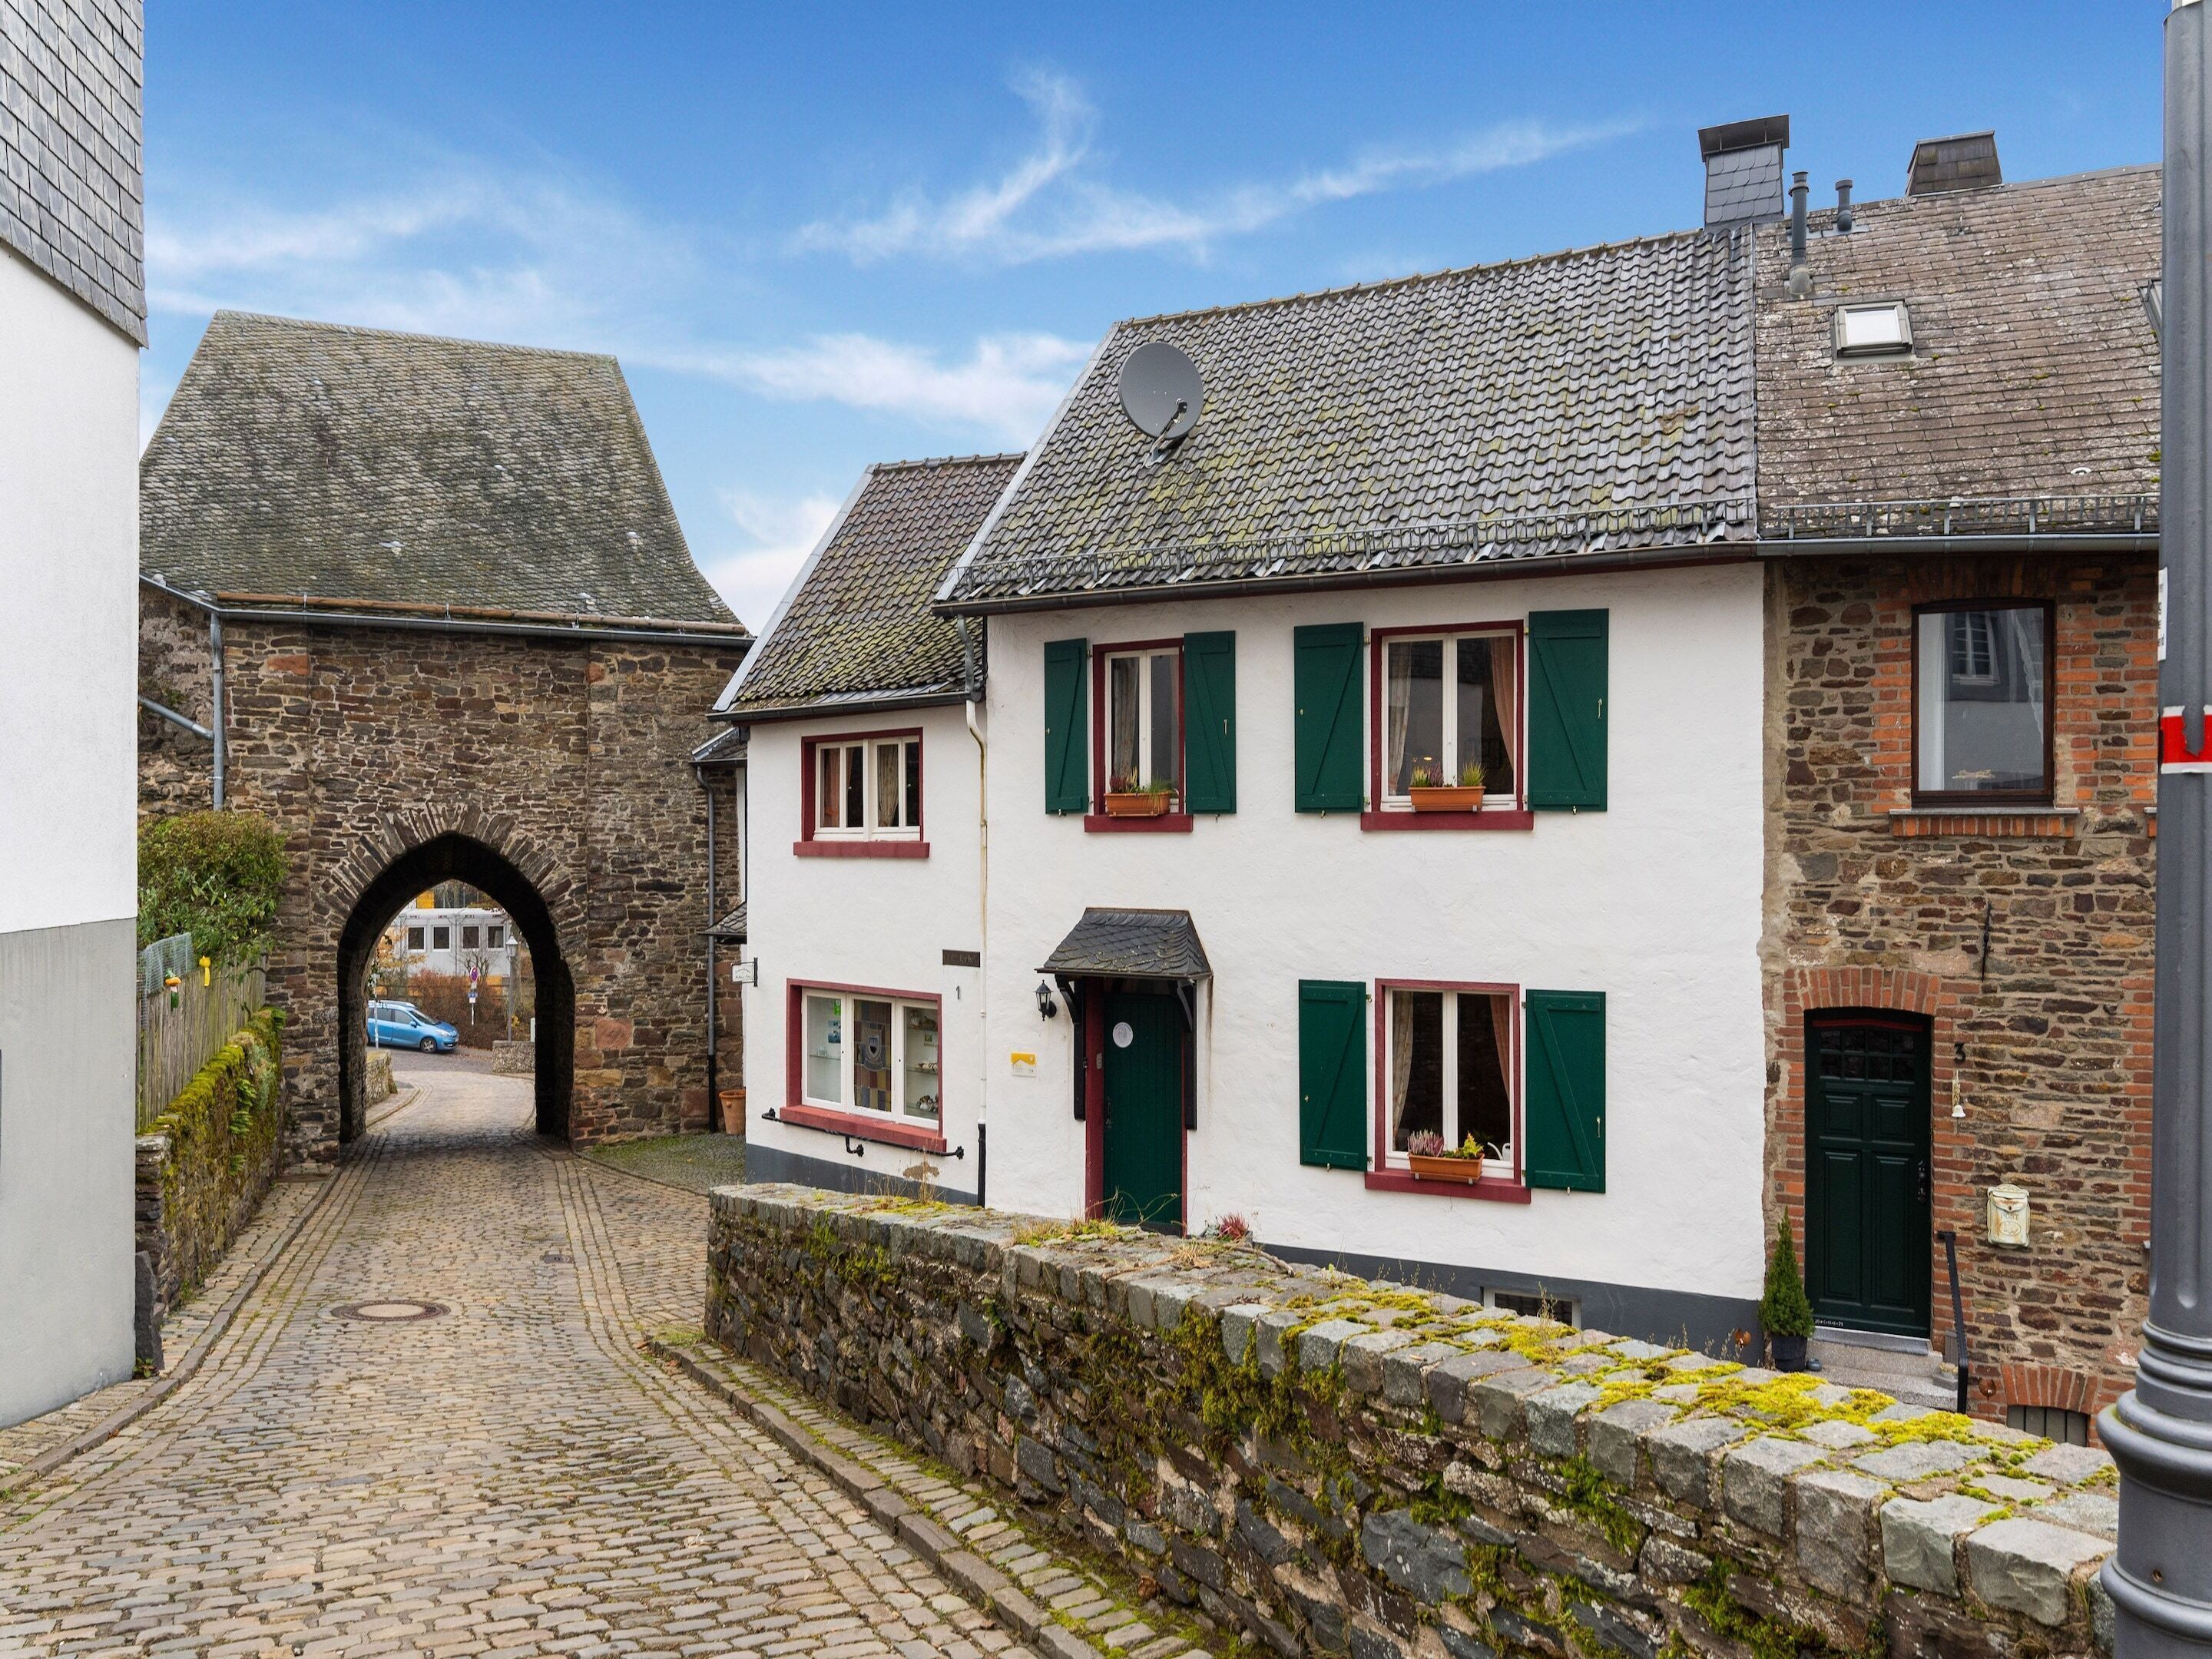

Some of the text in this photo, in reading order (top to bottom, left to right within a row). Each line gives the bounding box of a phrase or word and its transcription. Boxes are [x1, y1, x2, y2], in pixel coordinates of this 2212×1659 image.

[955, 985, 960, 1000] 1
[1954, 1042, 1966, 1064] 3
[2000, 1212, 2020, 1220] POST
